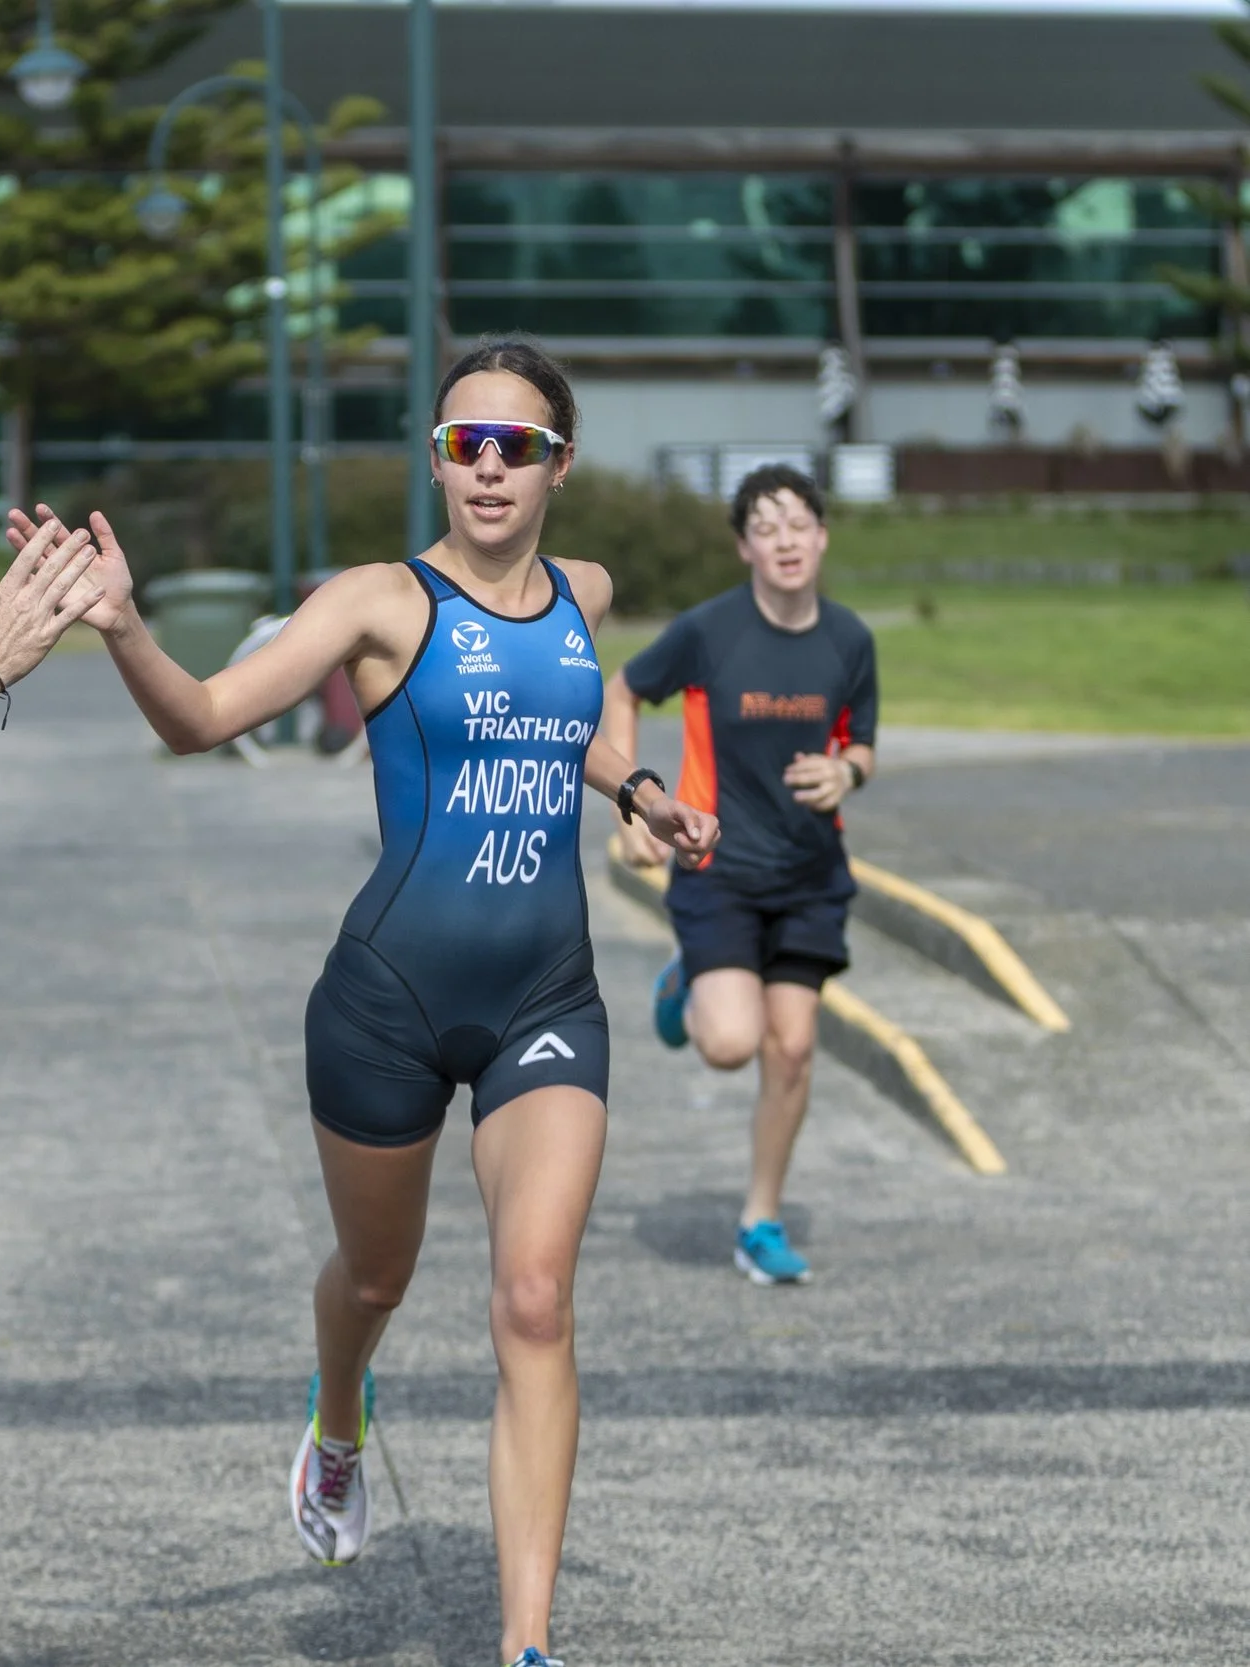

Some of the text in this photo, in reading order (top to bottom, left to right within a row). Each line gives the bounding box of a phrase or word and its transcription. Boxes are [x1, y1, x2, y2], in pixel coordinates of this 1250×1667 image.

[456, 663, 500, 675] Triathlon
[460, 653, 492, 664] World
[463, 691, 510, 715] VIC
[464, 717, 594, 745] TRIATHLON
[446, 759, 577, 815] ANDRICH
[466, 830, 546, 884] AUS
